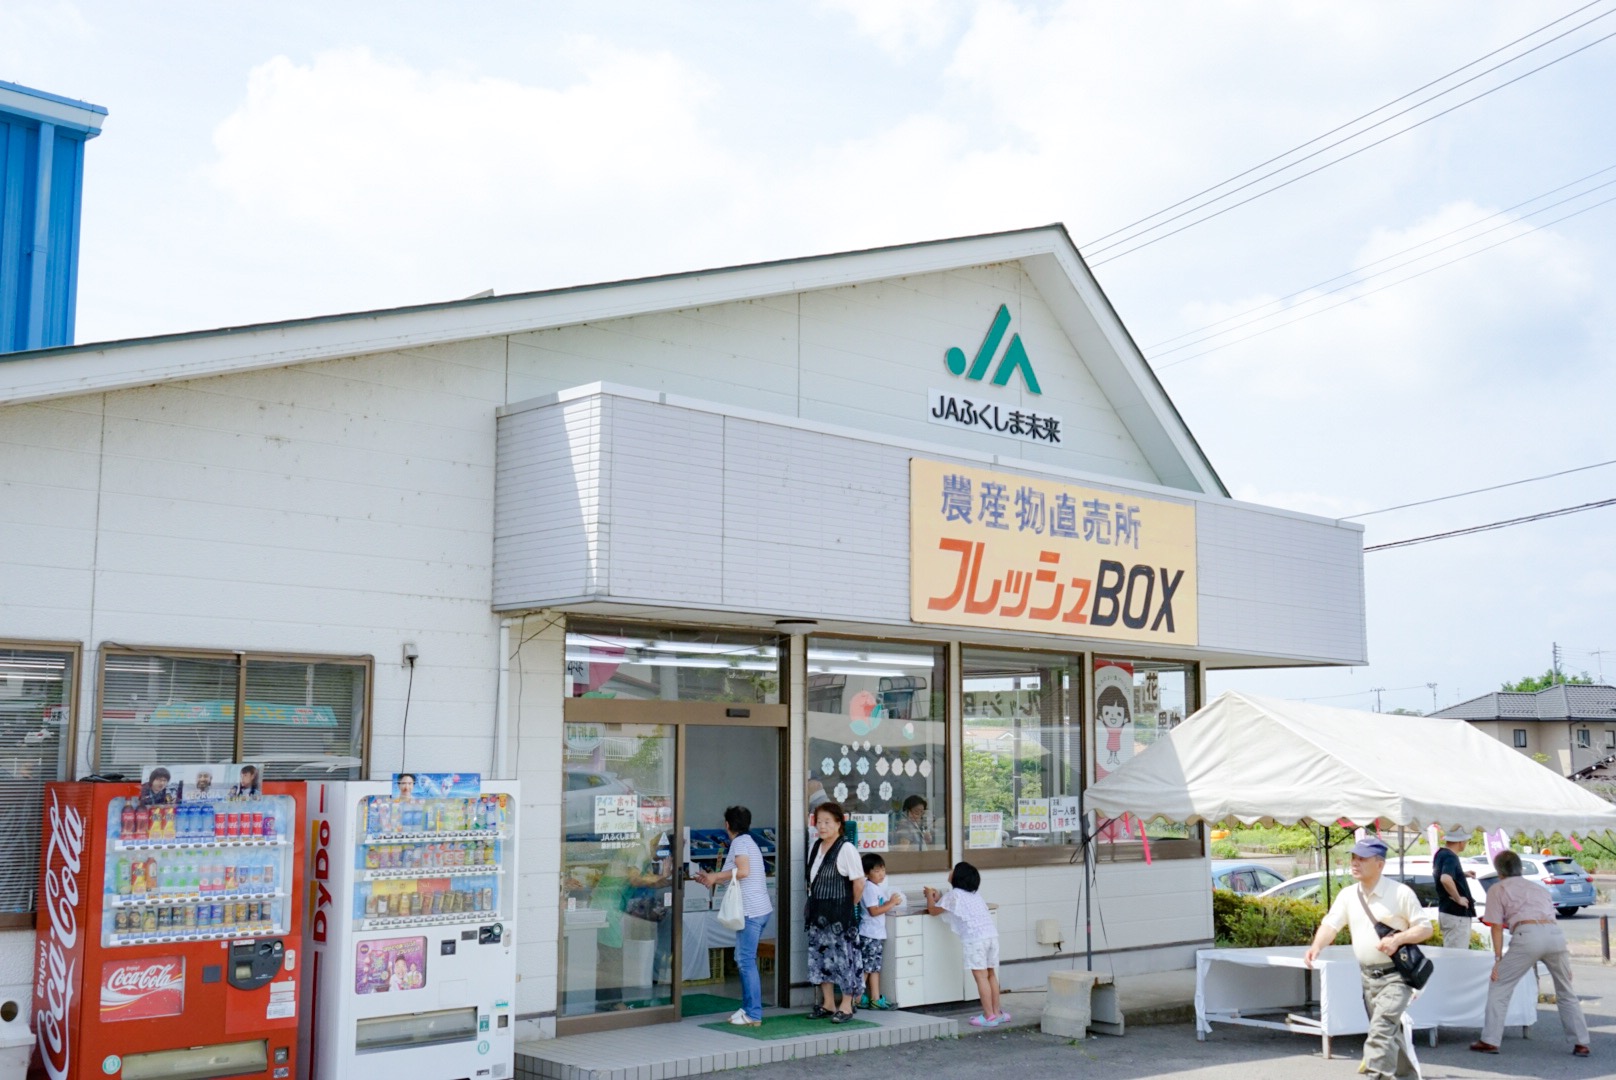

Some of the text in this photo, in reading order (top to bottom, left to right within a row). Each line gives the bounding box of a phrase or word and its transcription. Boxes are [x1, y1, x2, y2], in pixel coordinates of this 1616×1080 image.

[932, 395, 1061, 443] JAふくしま未来
[941, 474, 1142, 550] 農産物直売所
[928, 537, 1185, 633] フレッシュBOX
[598, 807, 634, 816] コーヒー
[37, 788, 83, 1080] Coca-Cola
[37, 940, 47, 998] Enjoy!
[107, 963, 176, 992] Coca-Cola
